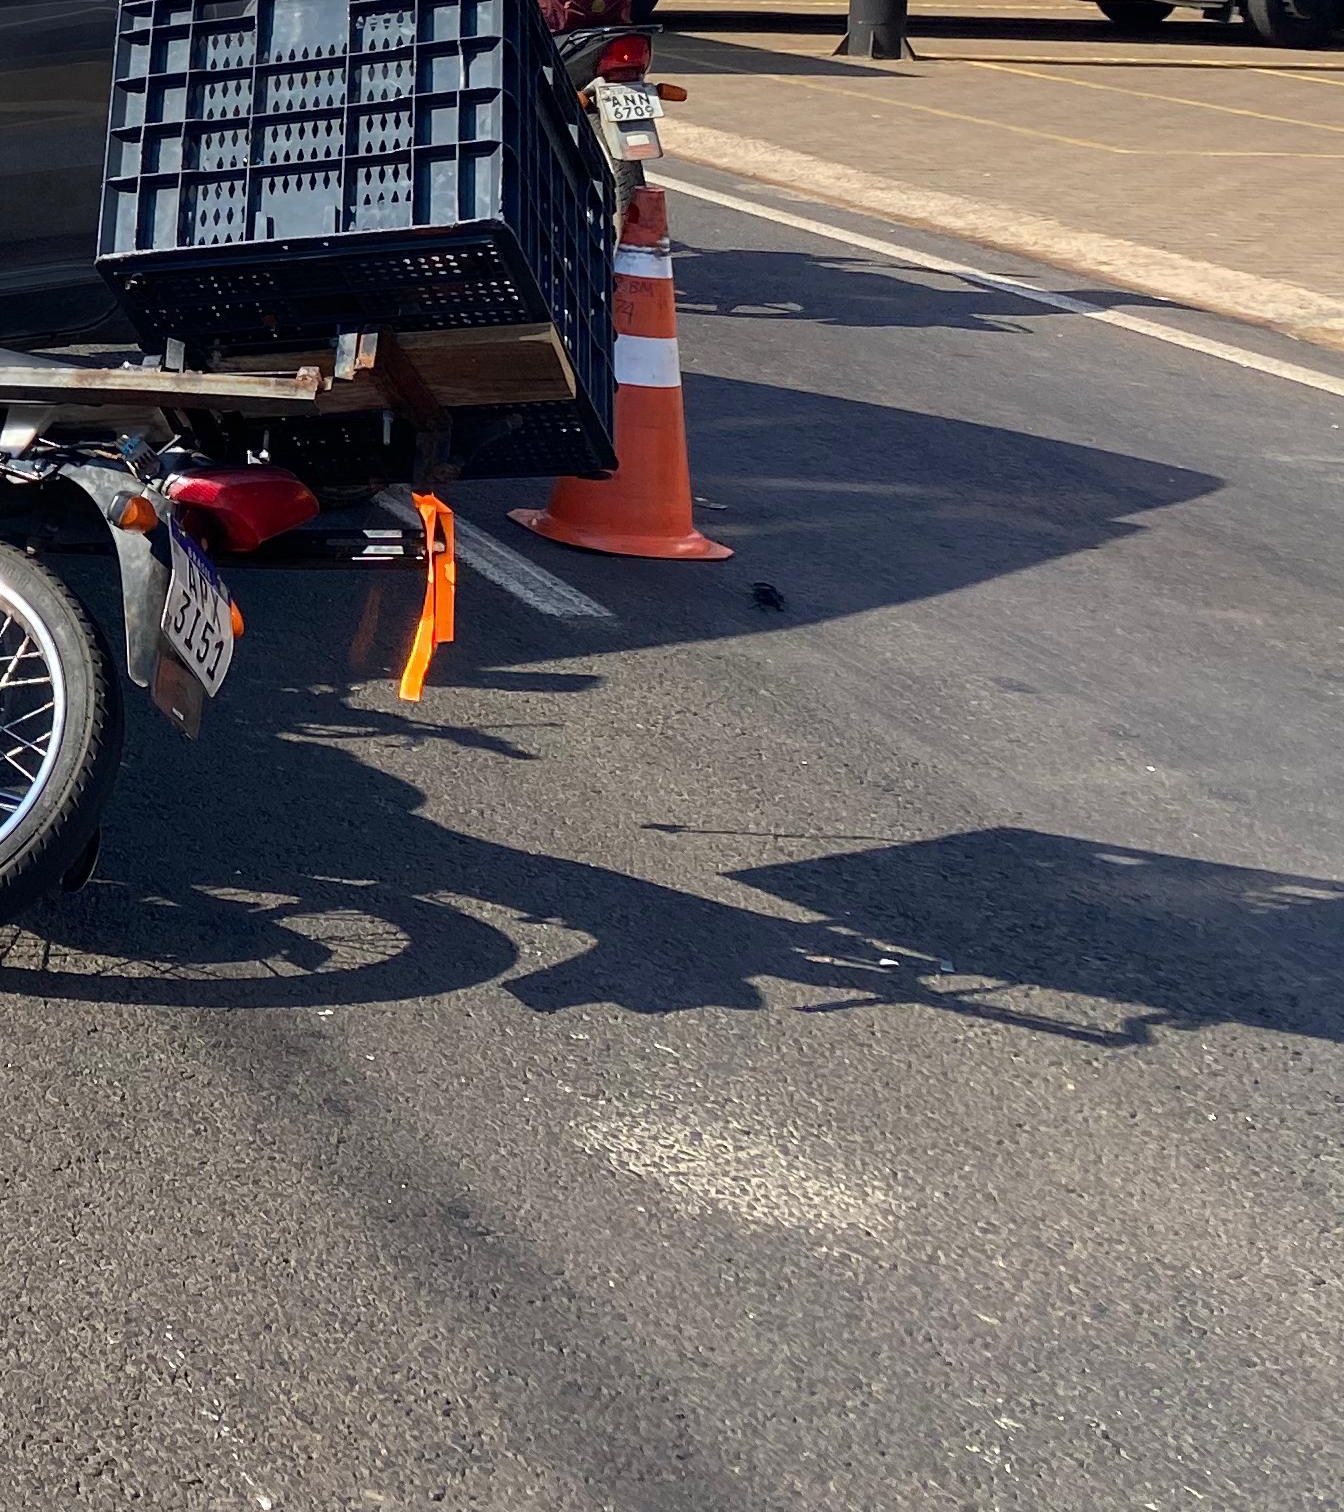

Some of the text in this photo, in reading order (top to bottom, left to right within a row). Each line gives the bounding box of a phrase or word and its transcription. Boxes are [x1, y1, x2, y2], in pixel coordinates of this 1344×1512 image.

[611, 93, 651, 108] ANN
[613, 105, 655, 120] 6709
[174, 589, 225, 681] 3151
